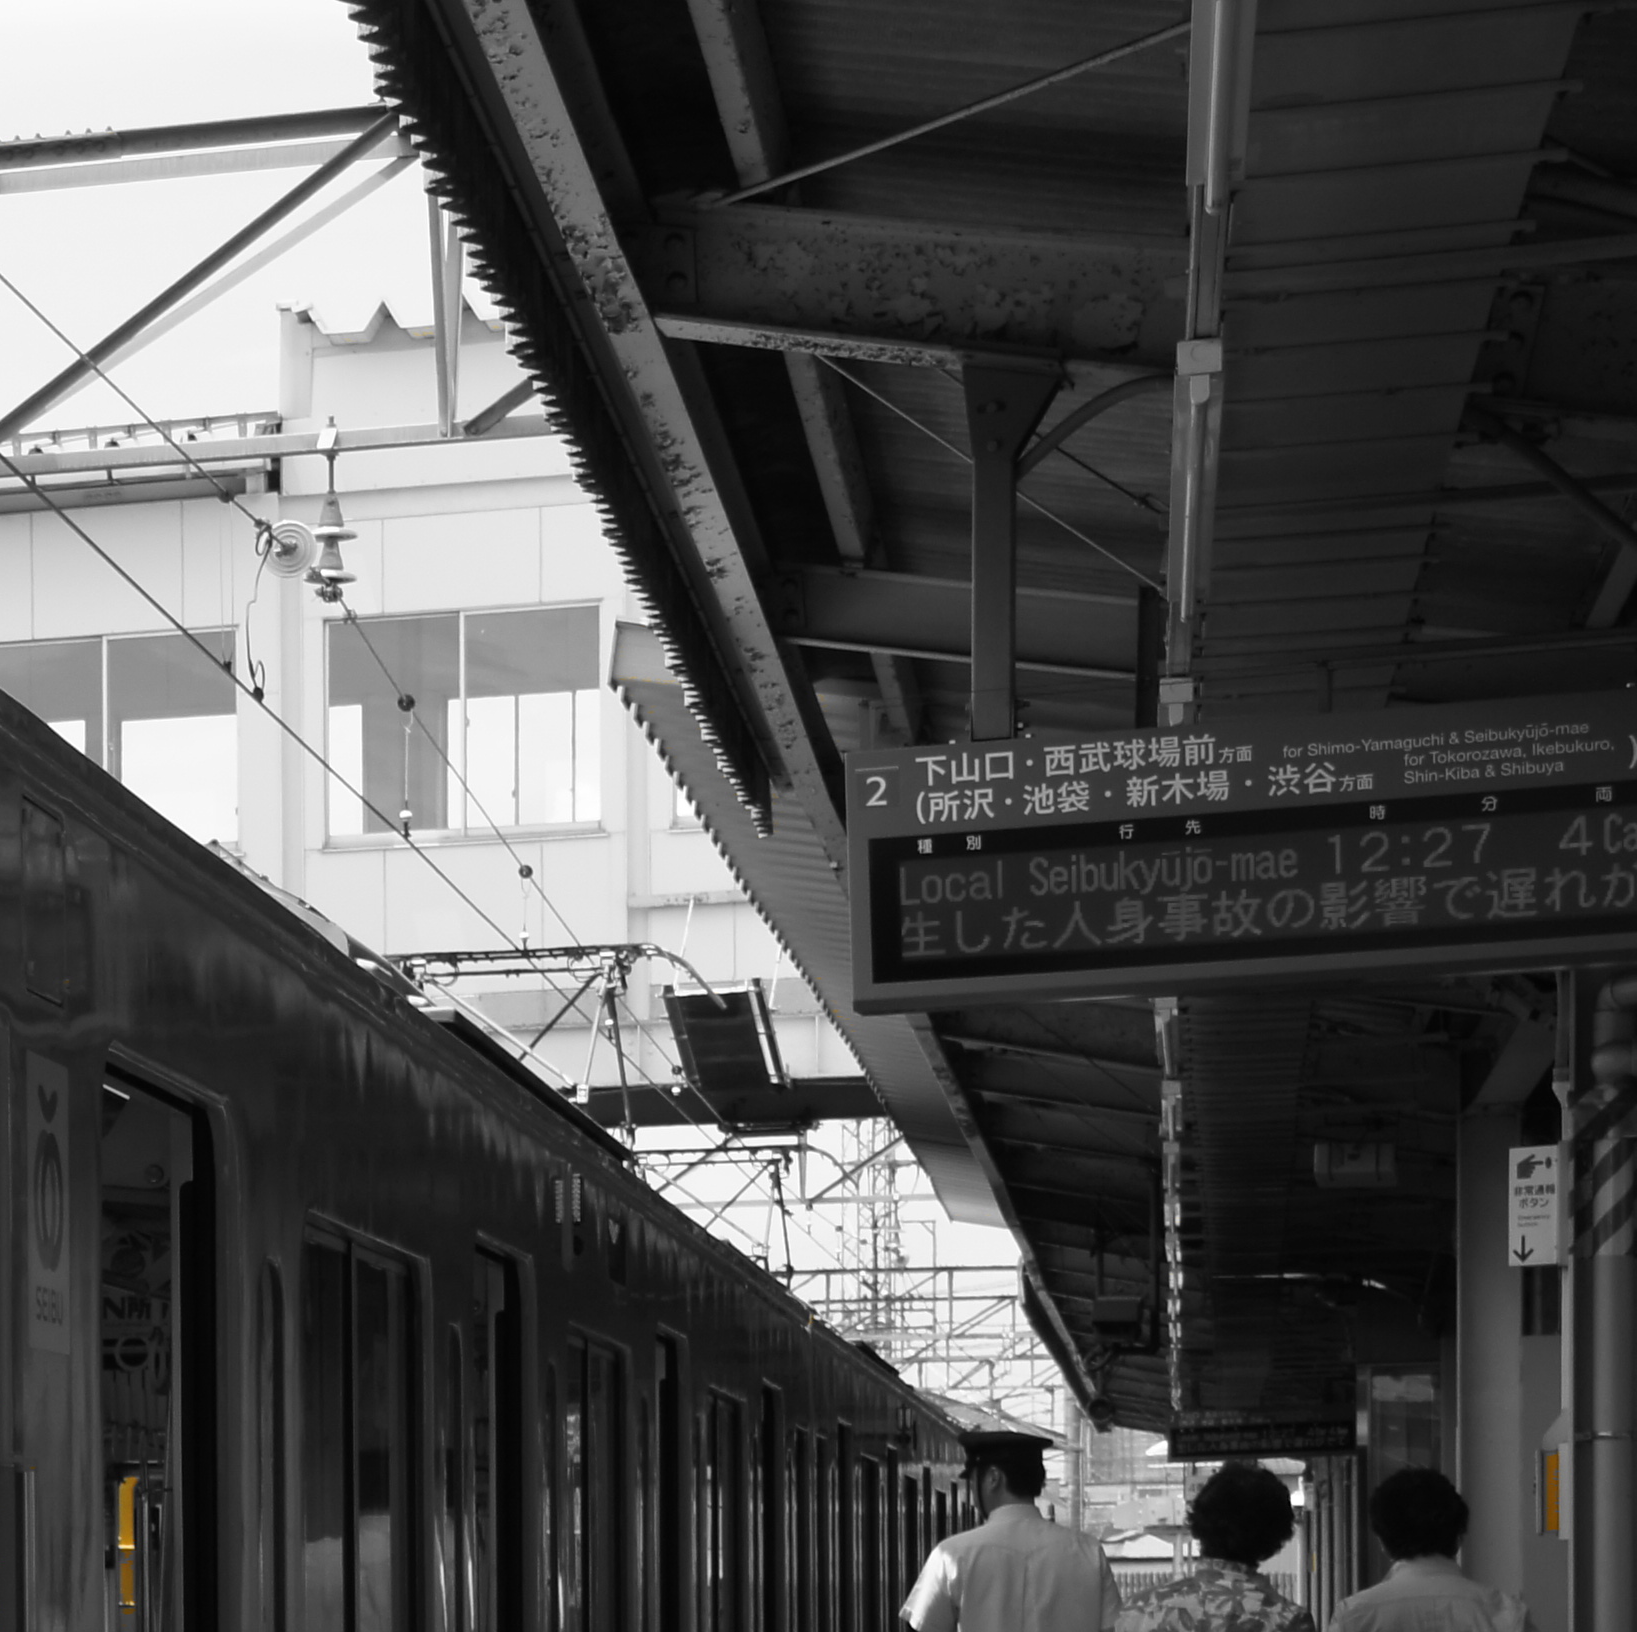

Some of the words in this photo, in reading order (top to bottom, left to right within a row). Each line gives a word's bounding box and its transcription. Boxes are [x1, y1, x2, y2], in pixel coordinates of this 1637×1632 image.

[1283, 745, 1303, 759] for
[1307, 732, 1444, 757] Shimo-Yamaguchi
[1448, 731, 1460, 745] &
[1403, 753, 1425, 767] for
[1429, 746, 1527, 765] Tokorozawa,
[1532, 738, 1615, 757] Ikebukuro,
[1404, 766, 1480, 785] Shin-Kiba
[1484, 764, 1496, 778] &
[1500, 760, 1564, 777] Shibuya
[865, 776, 888, 807] 2
[1481, 795, 1498, 812] 分
[1595, 786, 1613, 802] 両
[1368, 804, 1386, 821] 時
[899, 859, 1004, 906] Local
[1328, 822, 1492, 874] 12:27
[35, 1285, 64, 1327] SEIBU
